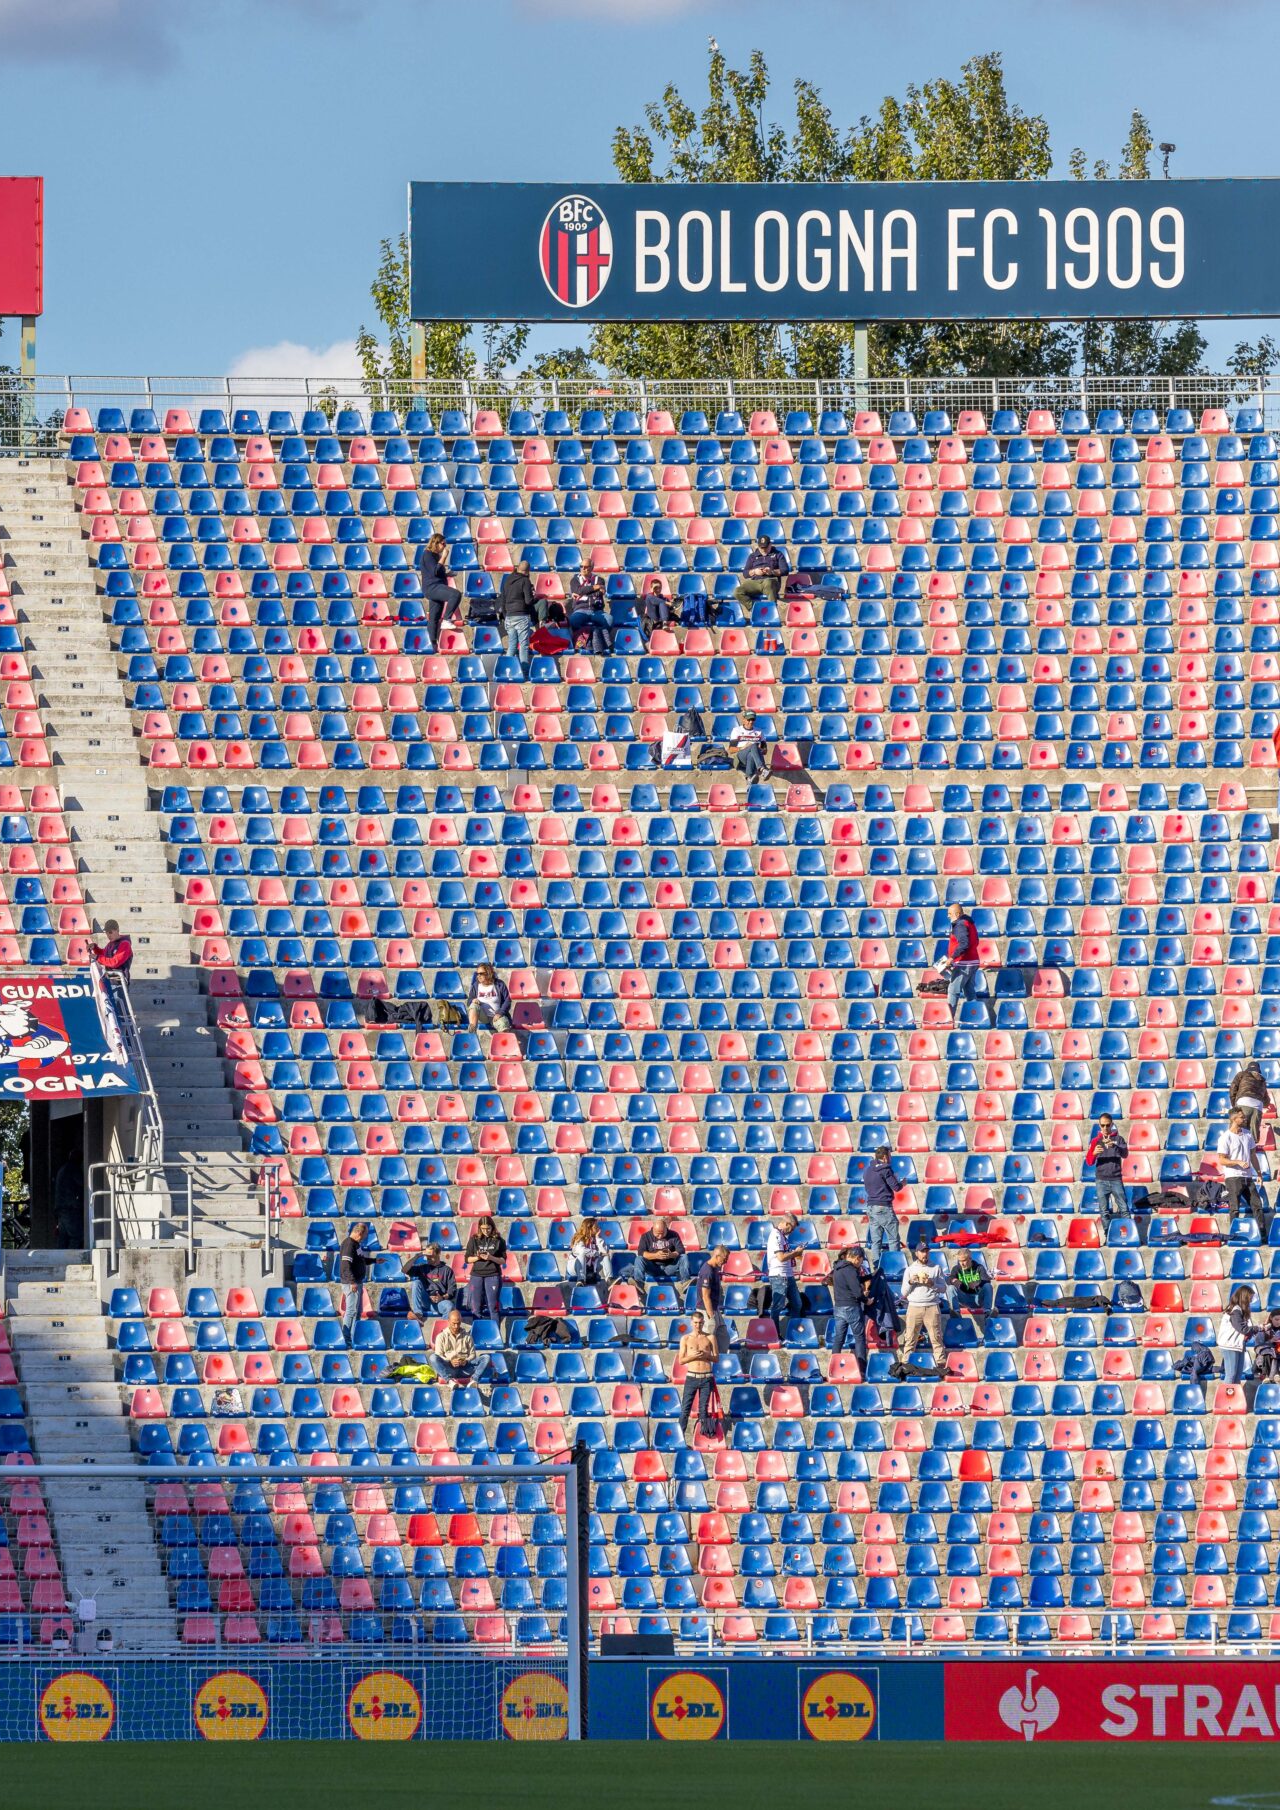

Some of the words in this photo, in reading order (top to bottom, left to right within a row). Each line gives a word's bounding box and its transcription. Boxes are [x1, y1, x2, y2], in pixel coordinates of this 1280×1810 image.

[559, 199, 593, 222] BFC
[563, 222, 588, 231] 1909
[635, 209, 917, 293] BOLOGNA
[948, 208, 1018, 291] FC
[1038, 206, 1185, 290] 1909
[61, 1052, 116, 1066] 1974
[1100, 1684, 1280, 1737] STRA
